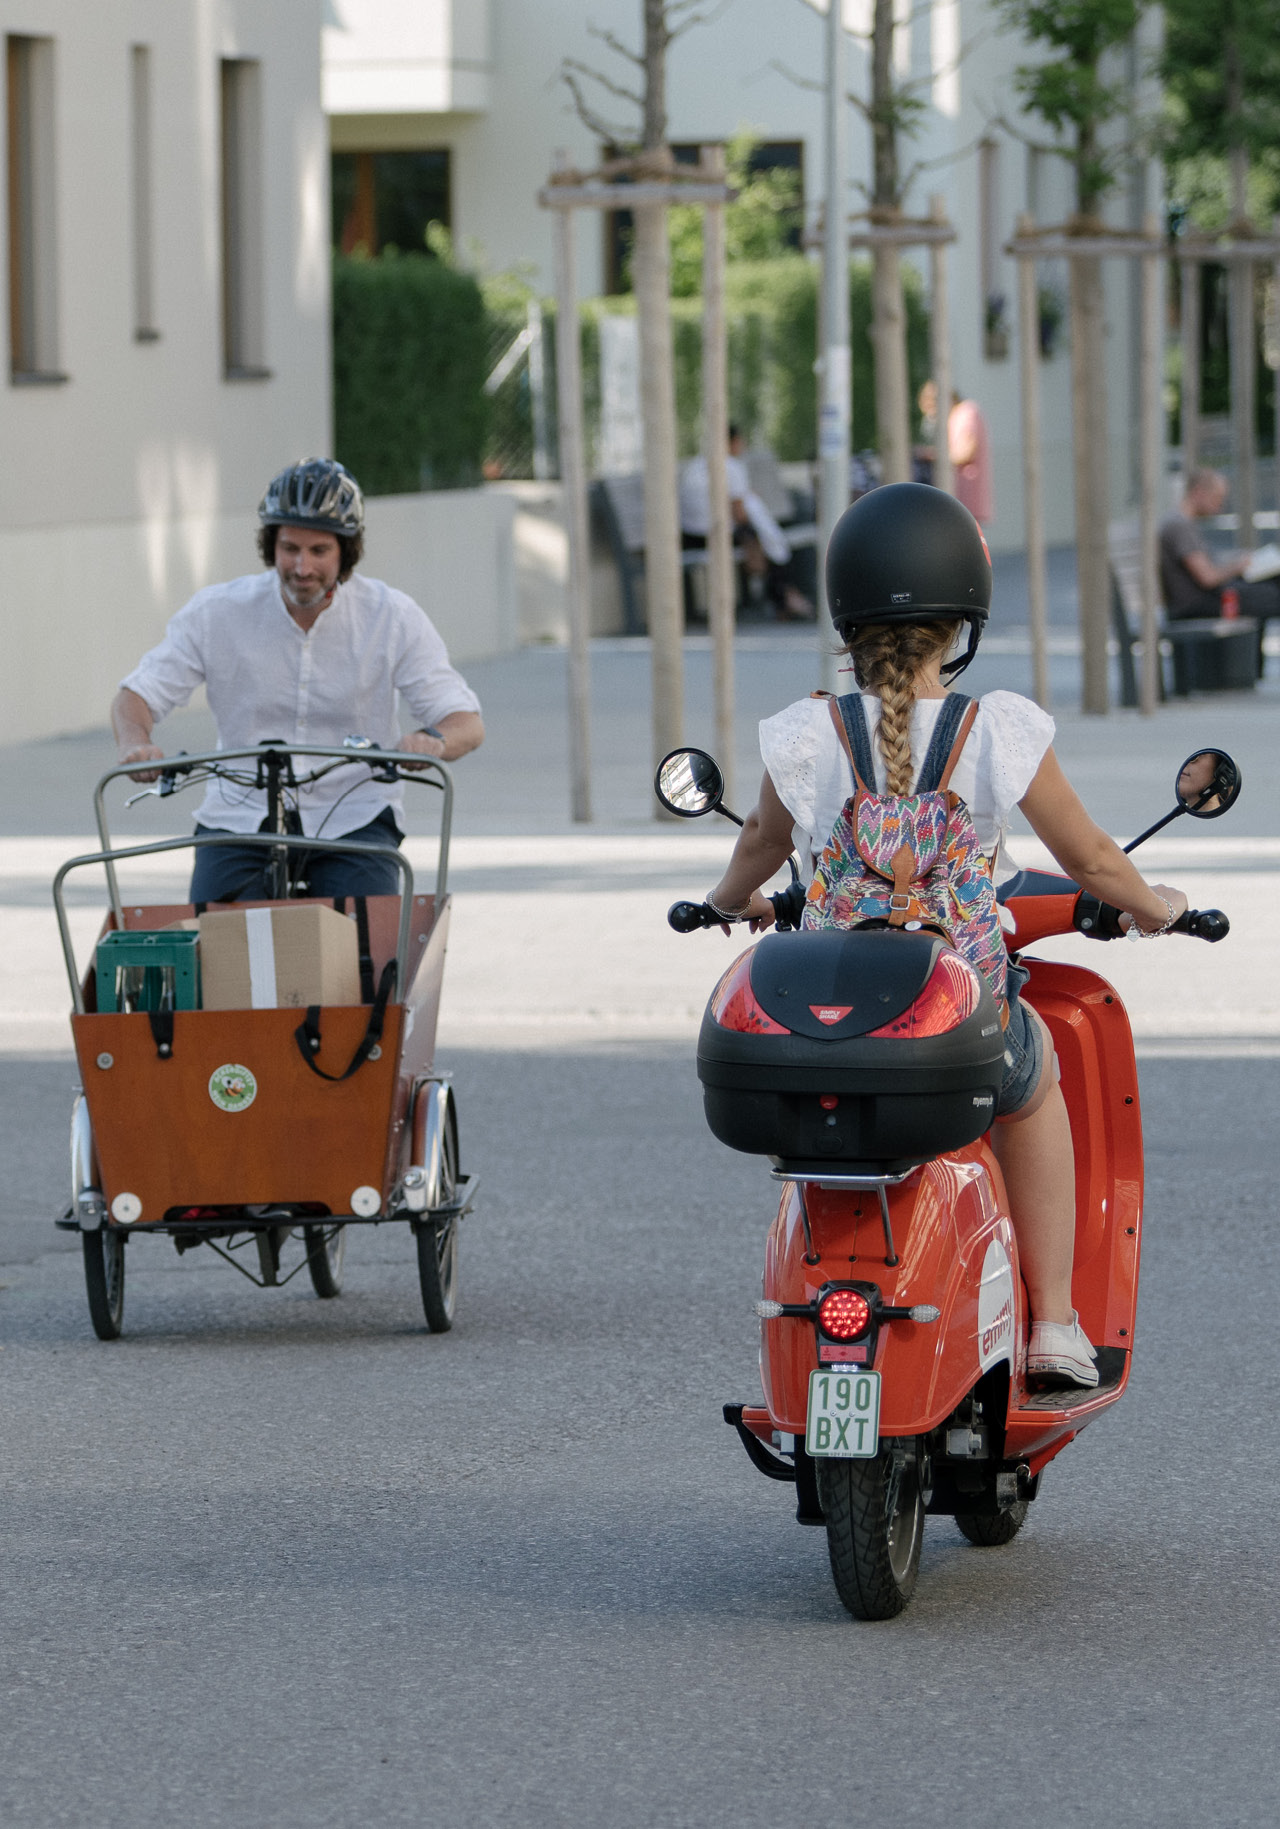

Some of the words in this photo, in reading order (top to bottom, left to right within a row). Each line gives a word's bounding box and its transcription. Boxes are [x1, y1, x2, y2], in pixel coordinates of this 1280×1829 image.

[983, 1292, 1012, 1356] emmy
[818, 1377, 871, 1411] 190
[815, 1416, 869, 1450] BXT
